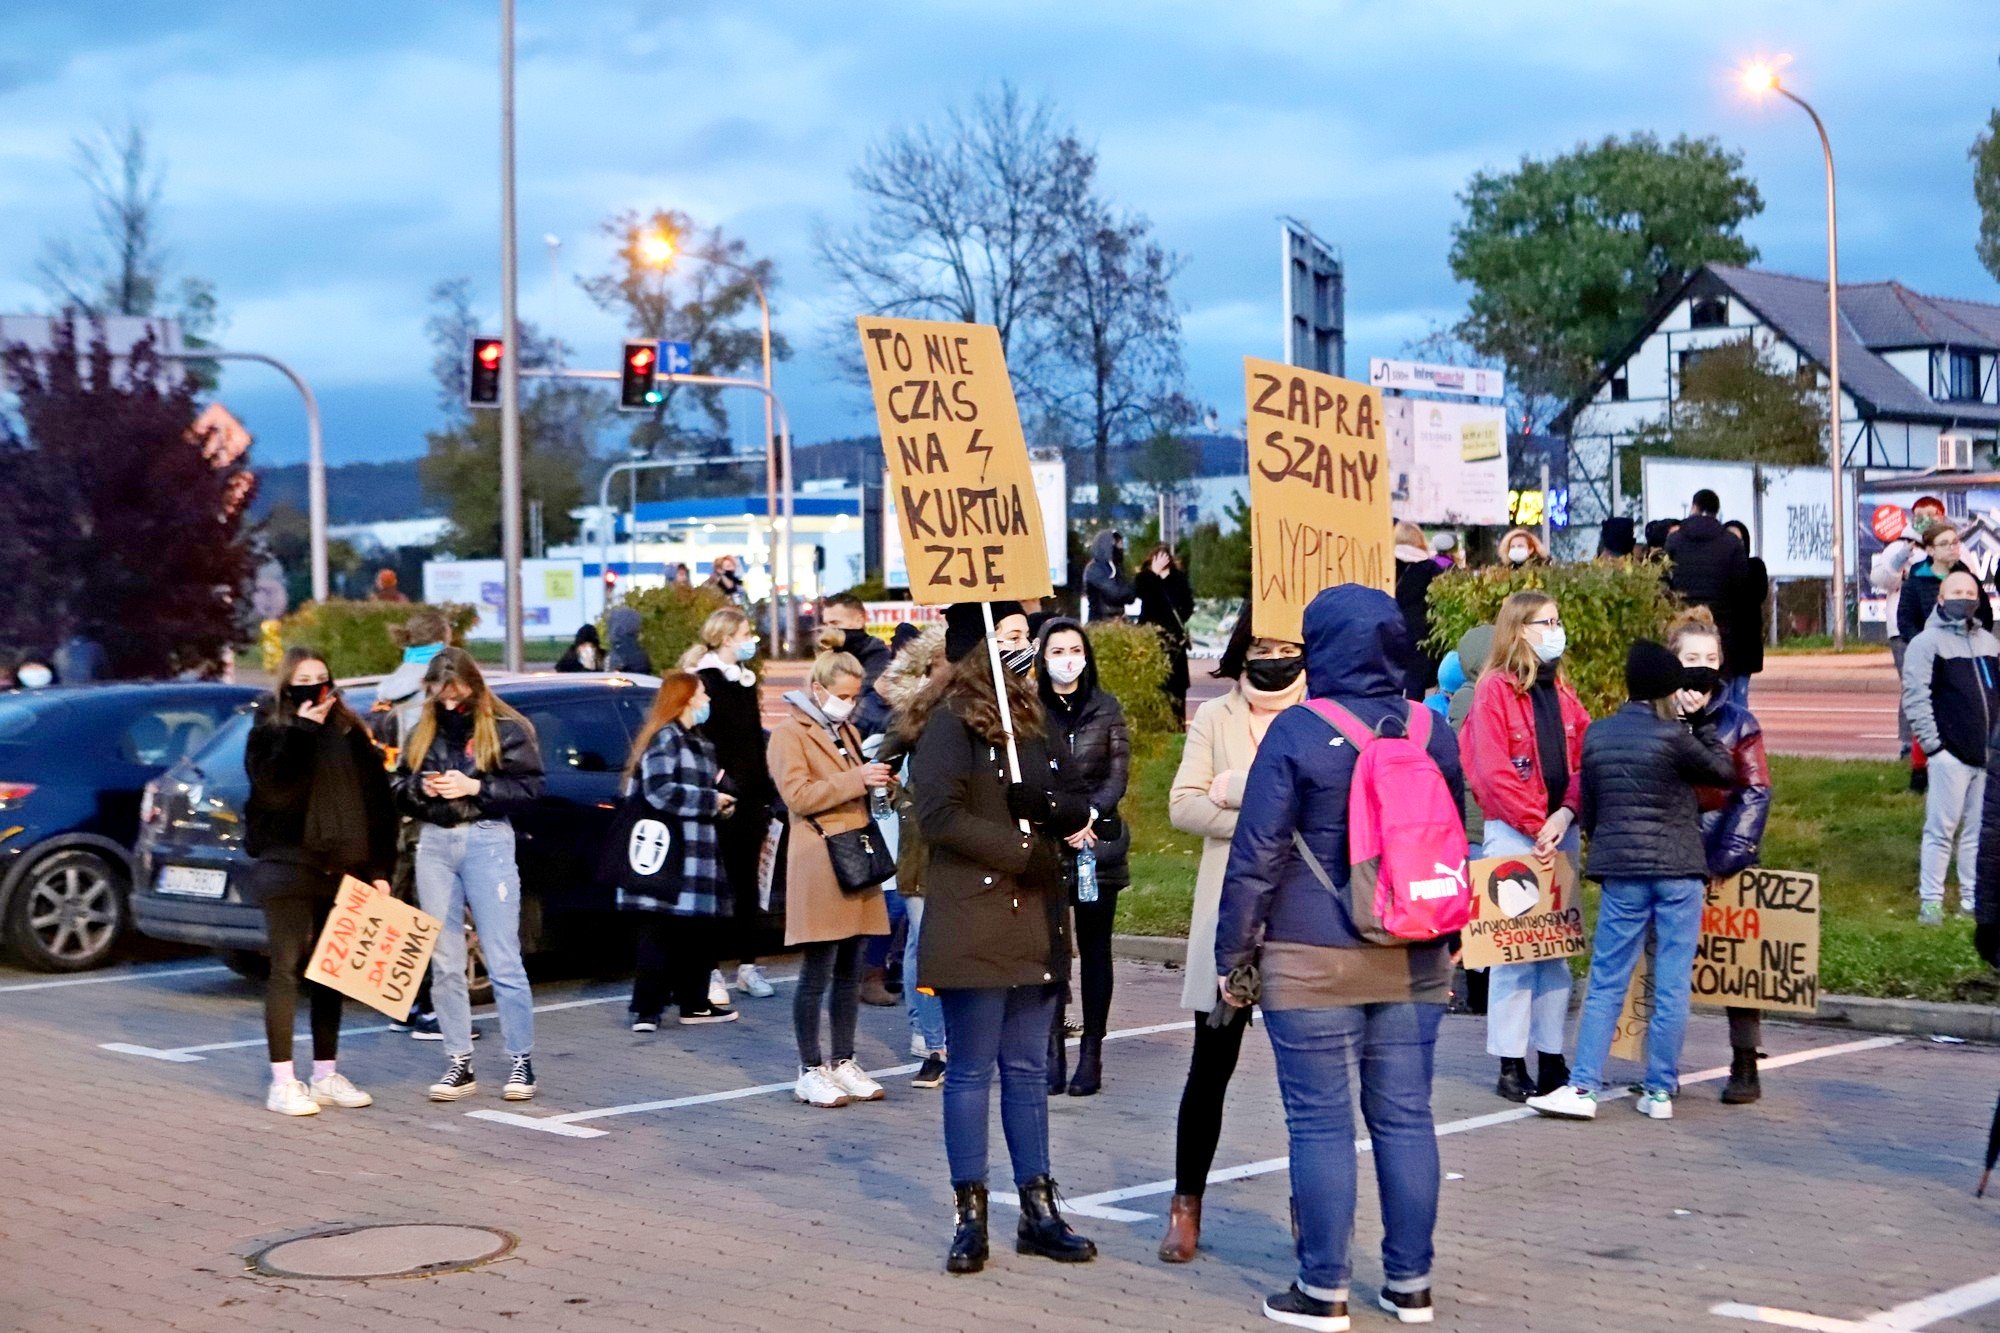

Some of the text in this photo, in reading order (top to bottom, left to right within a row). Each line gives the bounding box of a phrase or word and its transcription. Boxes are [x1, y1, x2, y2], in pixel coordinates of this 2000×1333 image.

[867, 328, 973, 375] TO NIE
[888, 380, 978, 423] CZAS
[897, 432, 949, 476] NA
[1257, 430, 1377, 505] SZAMY
[901, 483, 1028, 539] KURTUA
[924, 545, 1005, 592] ZJĘ
[346, 884, 371, 915] NIE
[1739, 870, 1815, 913] PRZEZ
[1470, 907, 1579, 937] CARBORUNDORUM
[1493, 922, 1582, 948] BASTARDES
[1503, 937, 1586, 962] NOLITE TE
[1761, 939, 1806, 974] NIE
[368, 961, 387, 988] DA
